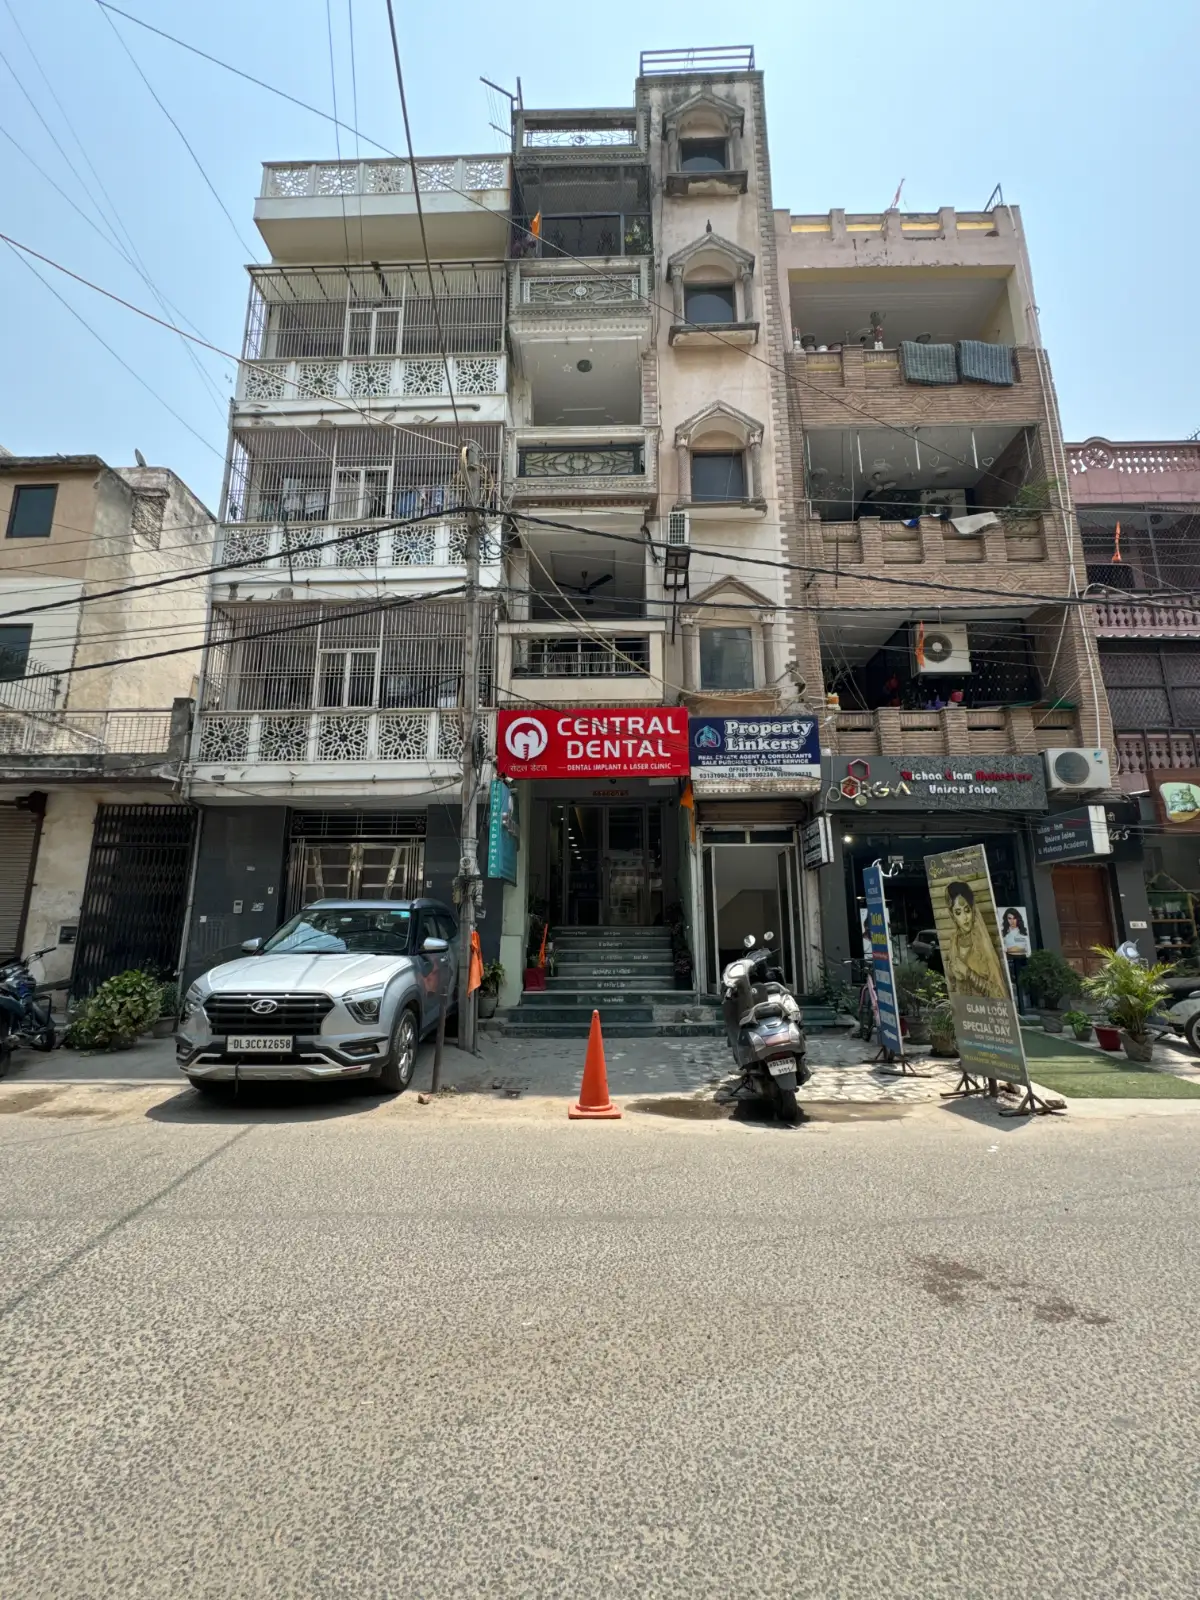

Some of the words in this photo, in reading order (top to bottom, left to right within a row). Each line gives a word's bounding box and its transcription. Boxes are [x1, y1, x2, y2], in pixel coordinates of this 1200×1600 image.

[557, 716, 681, 736] CENTRAL
[724, 720, 813, 737] Property
[567, 739, 672, 759] DENTAL
[593, 763, 621, 771] IMPLANT
[650, 762, 672, 770] CLINIC
[929, 784, 965, 794] Unisex
[968, 784, 998, 794] Salon
[1043, 844, 1063, 854] Makeup
[1063, 839, 1088, 850] Academy
[966, 1003, 986, 1014] GLAM
[987, 1005, 1009, 1018] LOOK
[962, 1020, 994, 1034] SPECIAL
[994, 1024, 1011, 1037] DAY
[233, 1039, 291, 1049] DL3CCX2658
